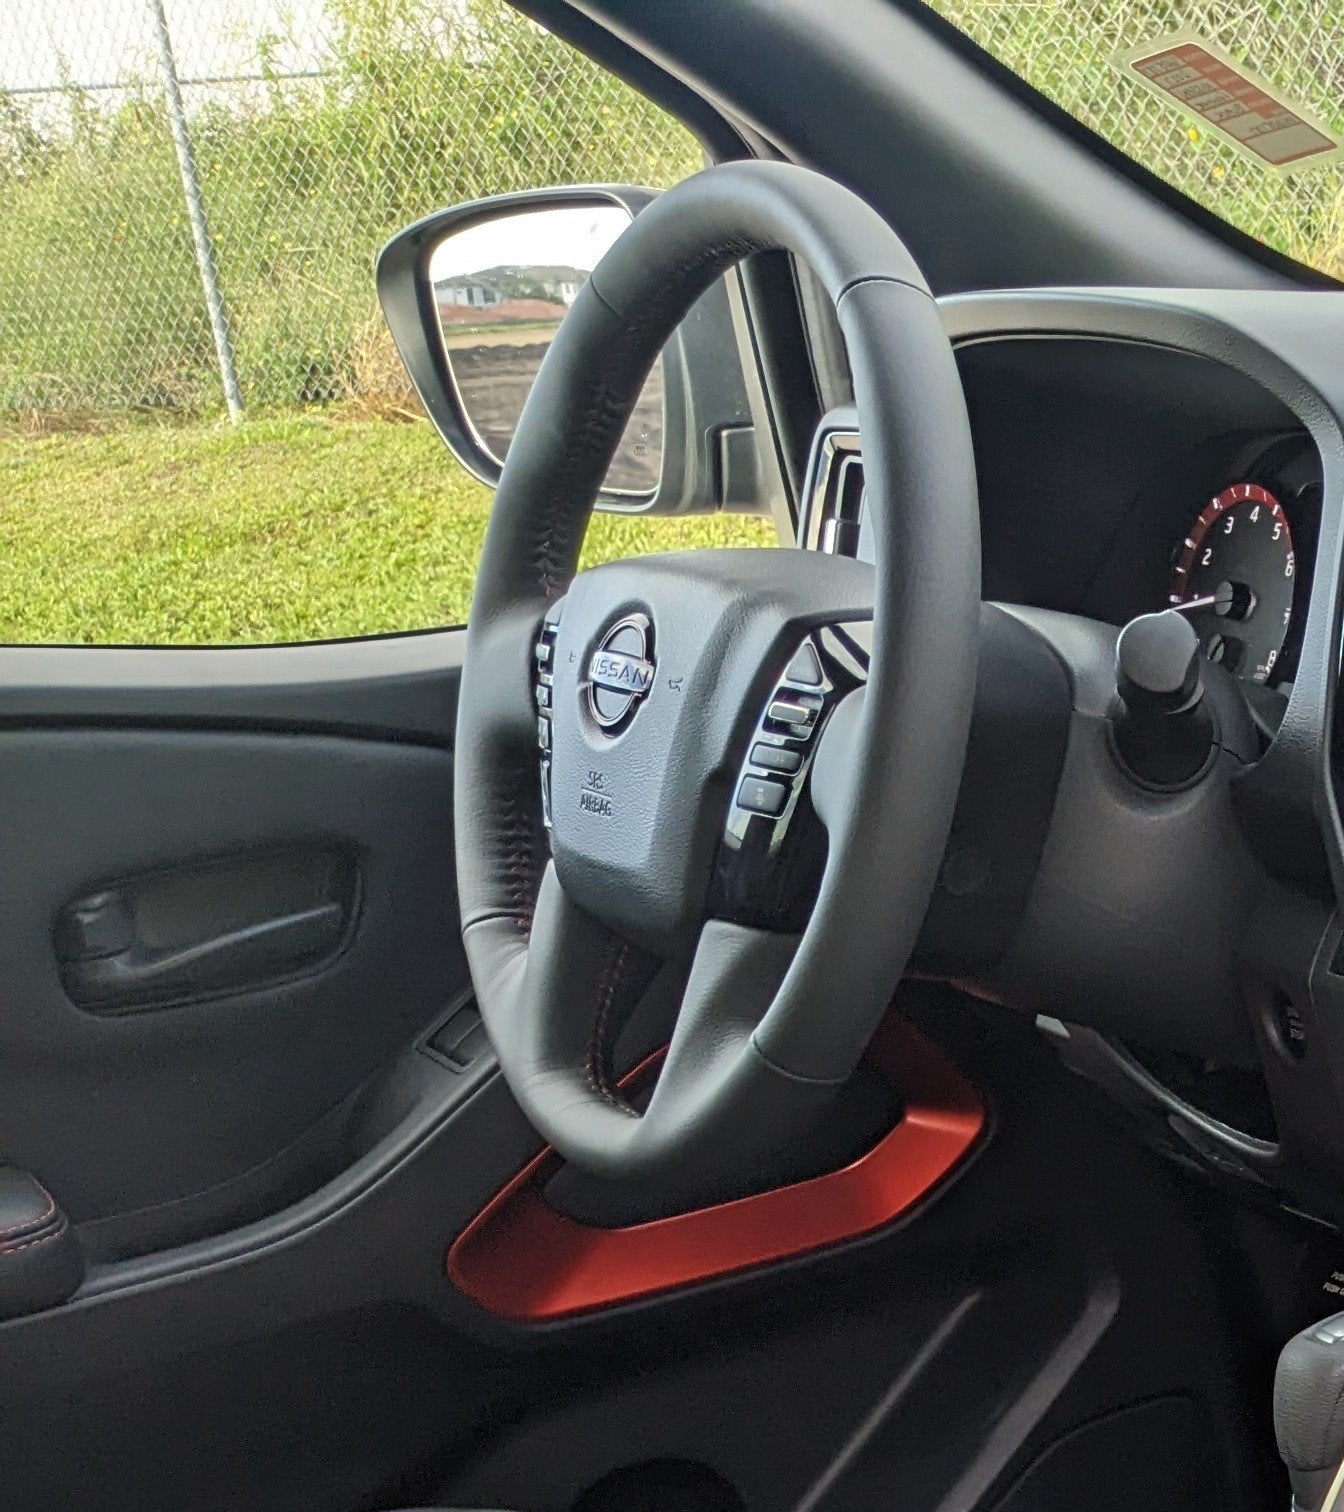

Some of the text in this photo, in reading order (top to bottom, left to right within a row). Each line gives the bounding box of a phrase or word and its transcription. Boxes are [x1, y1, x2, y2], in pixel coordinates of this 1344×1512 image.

[1249, 505, 1260, 522] 4
[1224, 516, 1234, 535] 3
[1271, 522, 1282, 540] 5
[1201, 548, 1212, 566] 2
